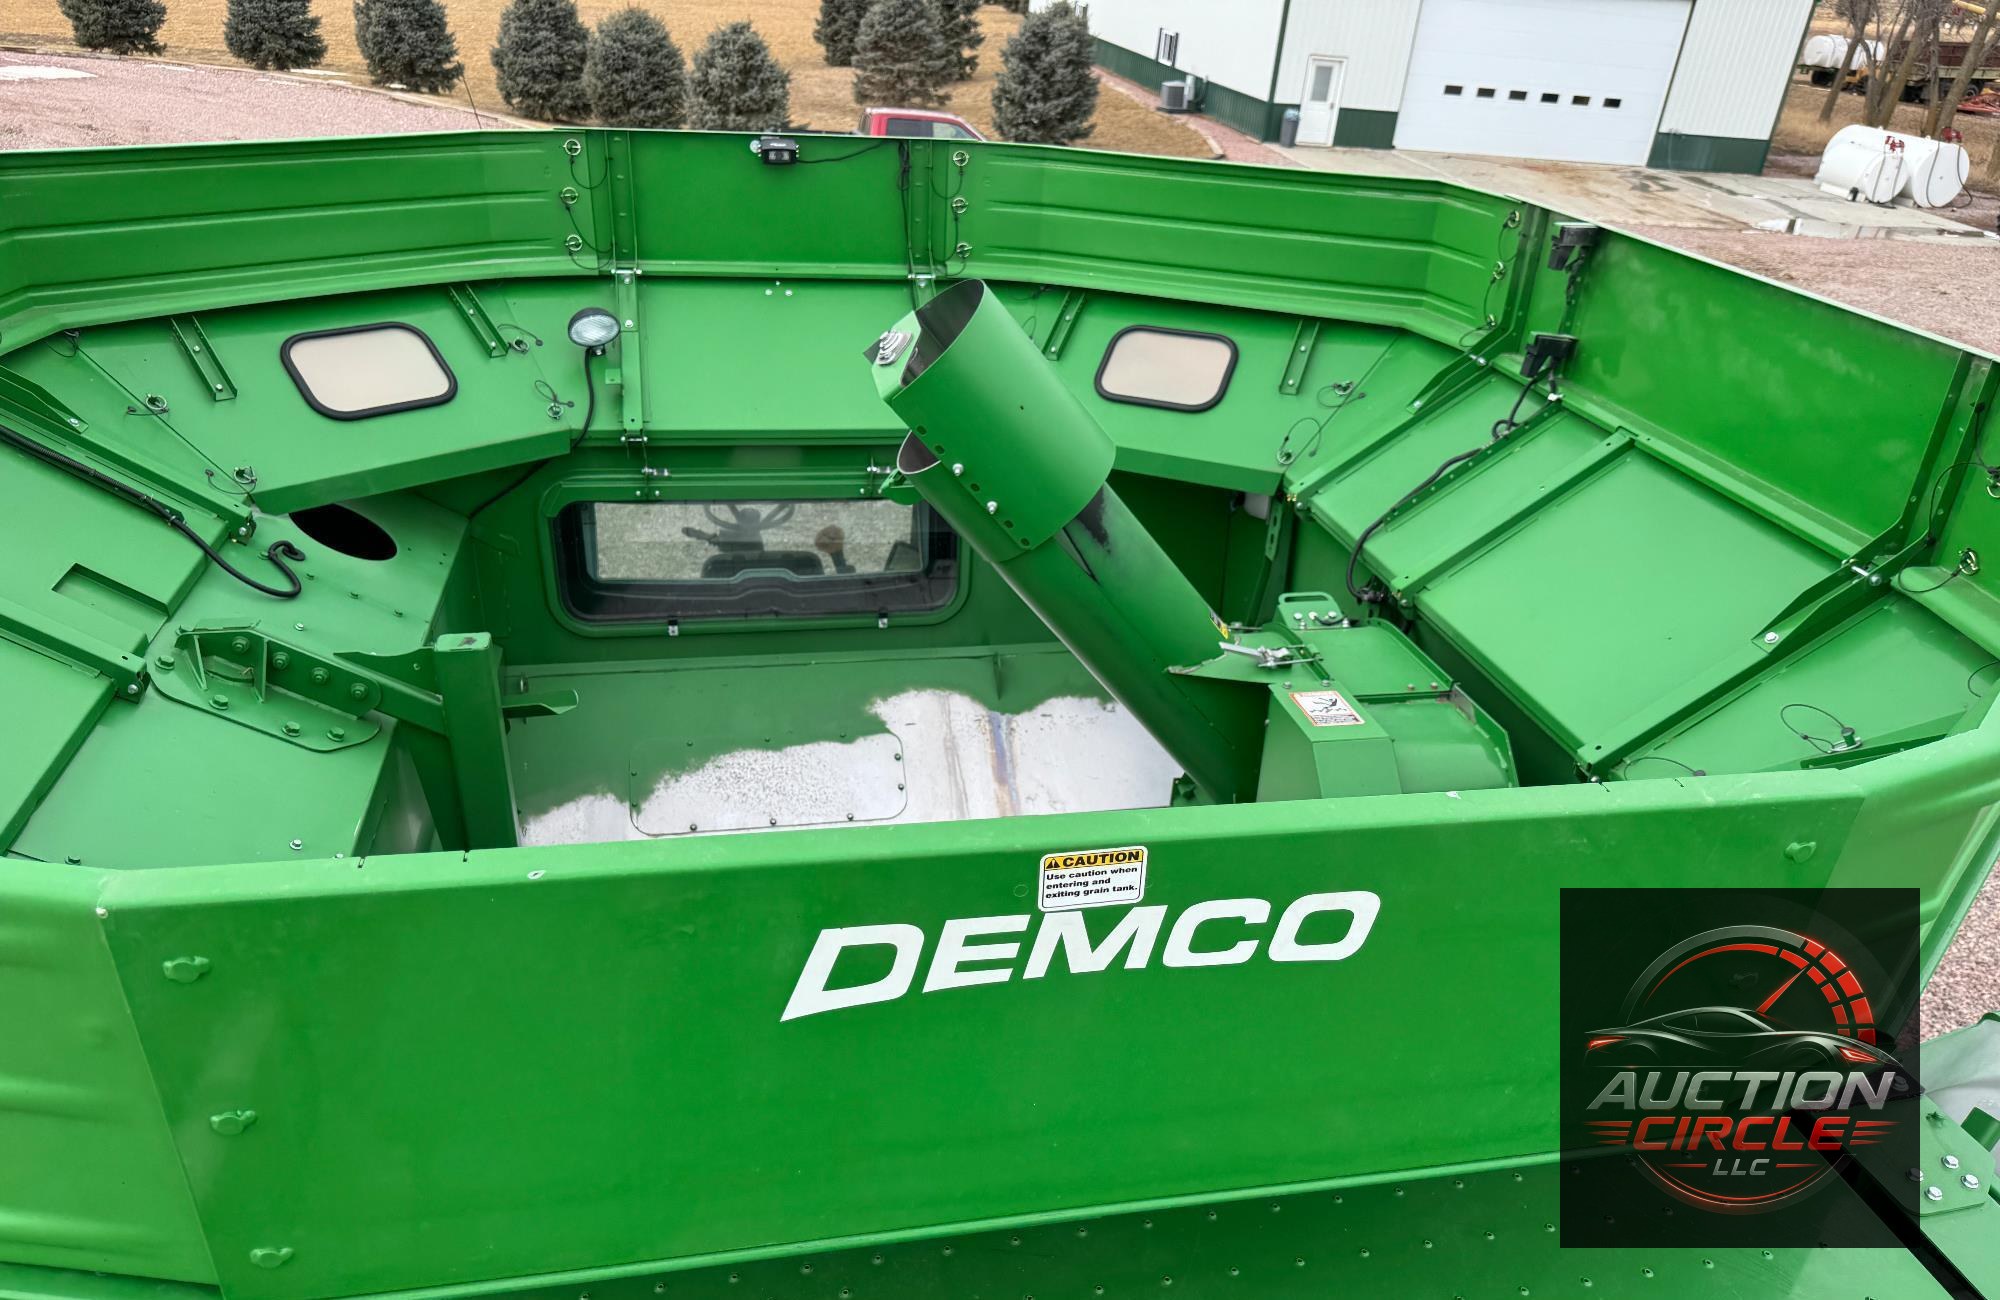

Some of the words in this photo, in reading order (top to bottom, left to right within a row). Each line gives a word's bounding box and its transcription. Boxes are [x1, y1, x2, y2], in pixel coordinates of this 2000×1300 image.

[1062, 851, 1140, 867] CAUTION
[1068, 869, 1107, 879] caution
[1110, 867, 1138, 875] when
[1046, 880, 1089, 890] entering
[1091, 877, 1111, 885] and
[1045, 889, 1080, 899] exiting
[1083, 887, 1110, 896] grain
[1112, 884, 1138, 892] tank.
[779, 889, 1381, 1022] DEMCO
